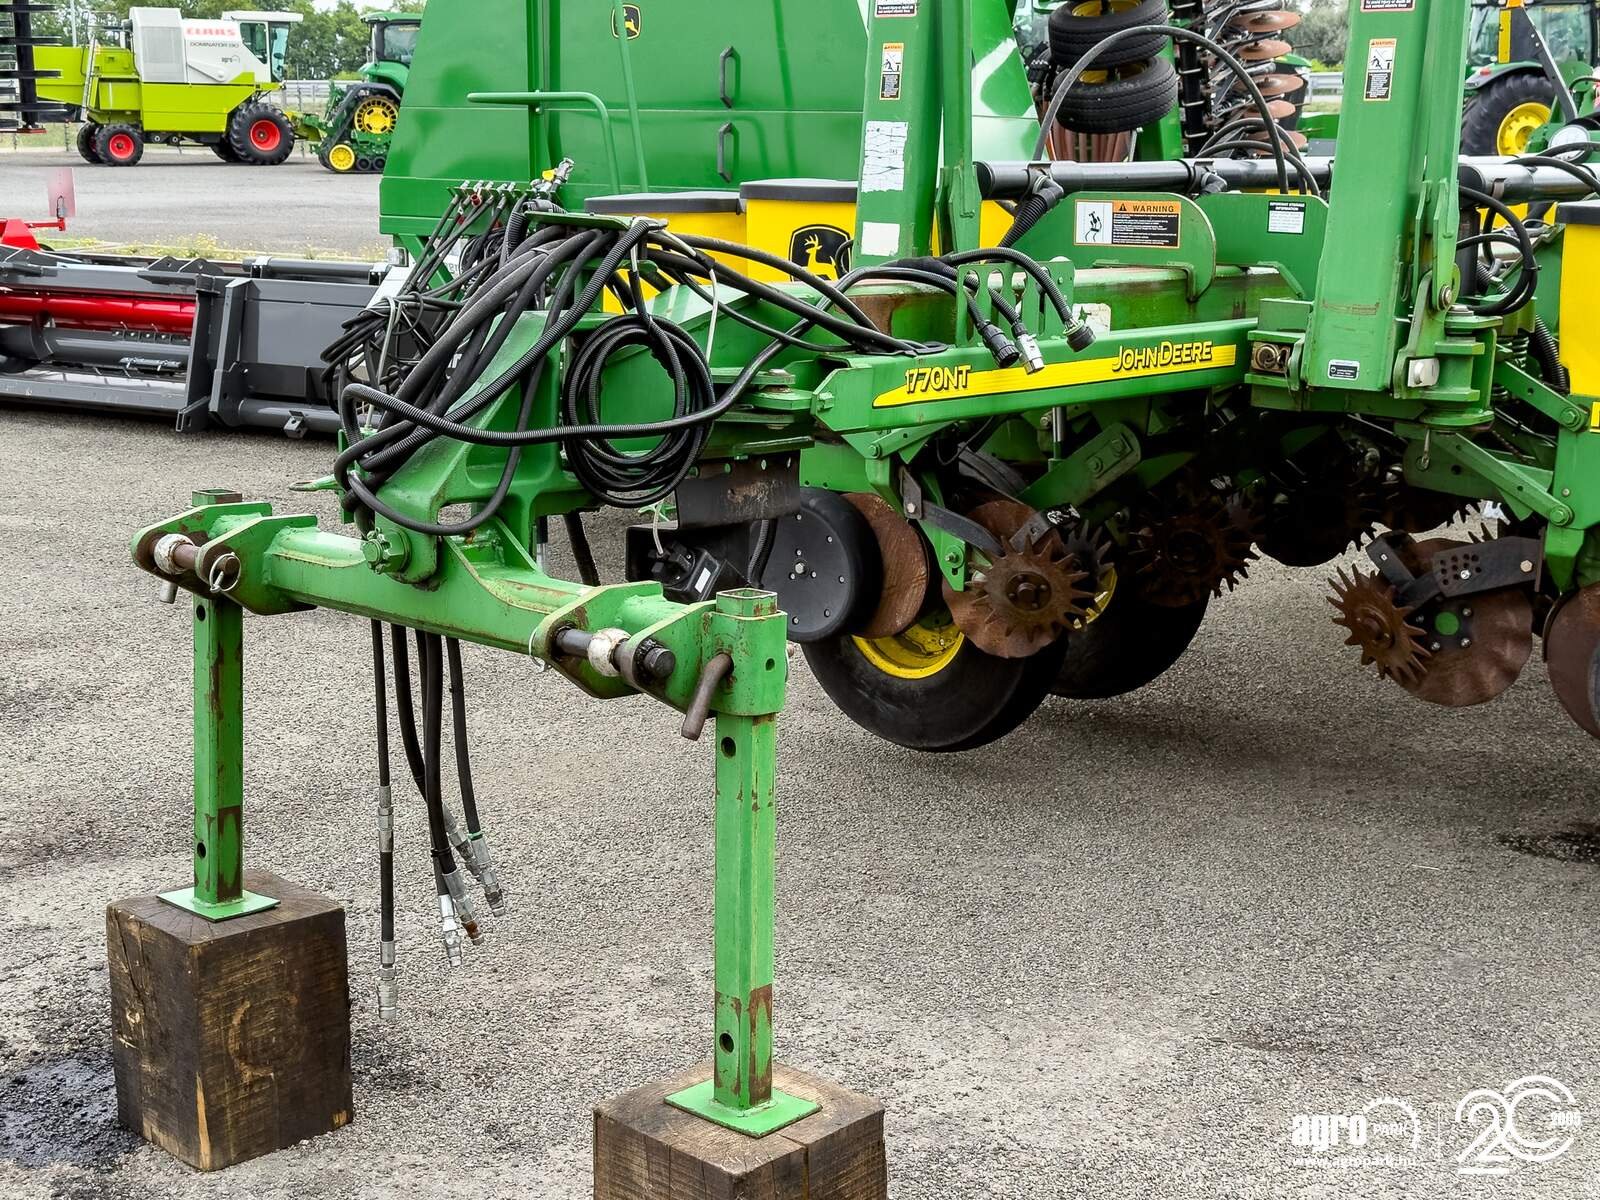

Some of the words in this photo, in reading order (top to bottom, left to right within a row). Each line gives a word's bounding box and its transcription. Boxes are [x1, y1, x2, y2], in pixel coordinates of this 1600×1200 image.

[1132, 205, 1175, 213] WARNING
[1112, 346, 1159, 373] JOHN
[1158, 341, 1213, 366] DEERE
[904, 364, 972, 393] 1770NT
